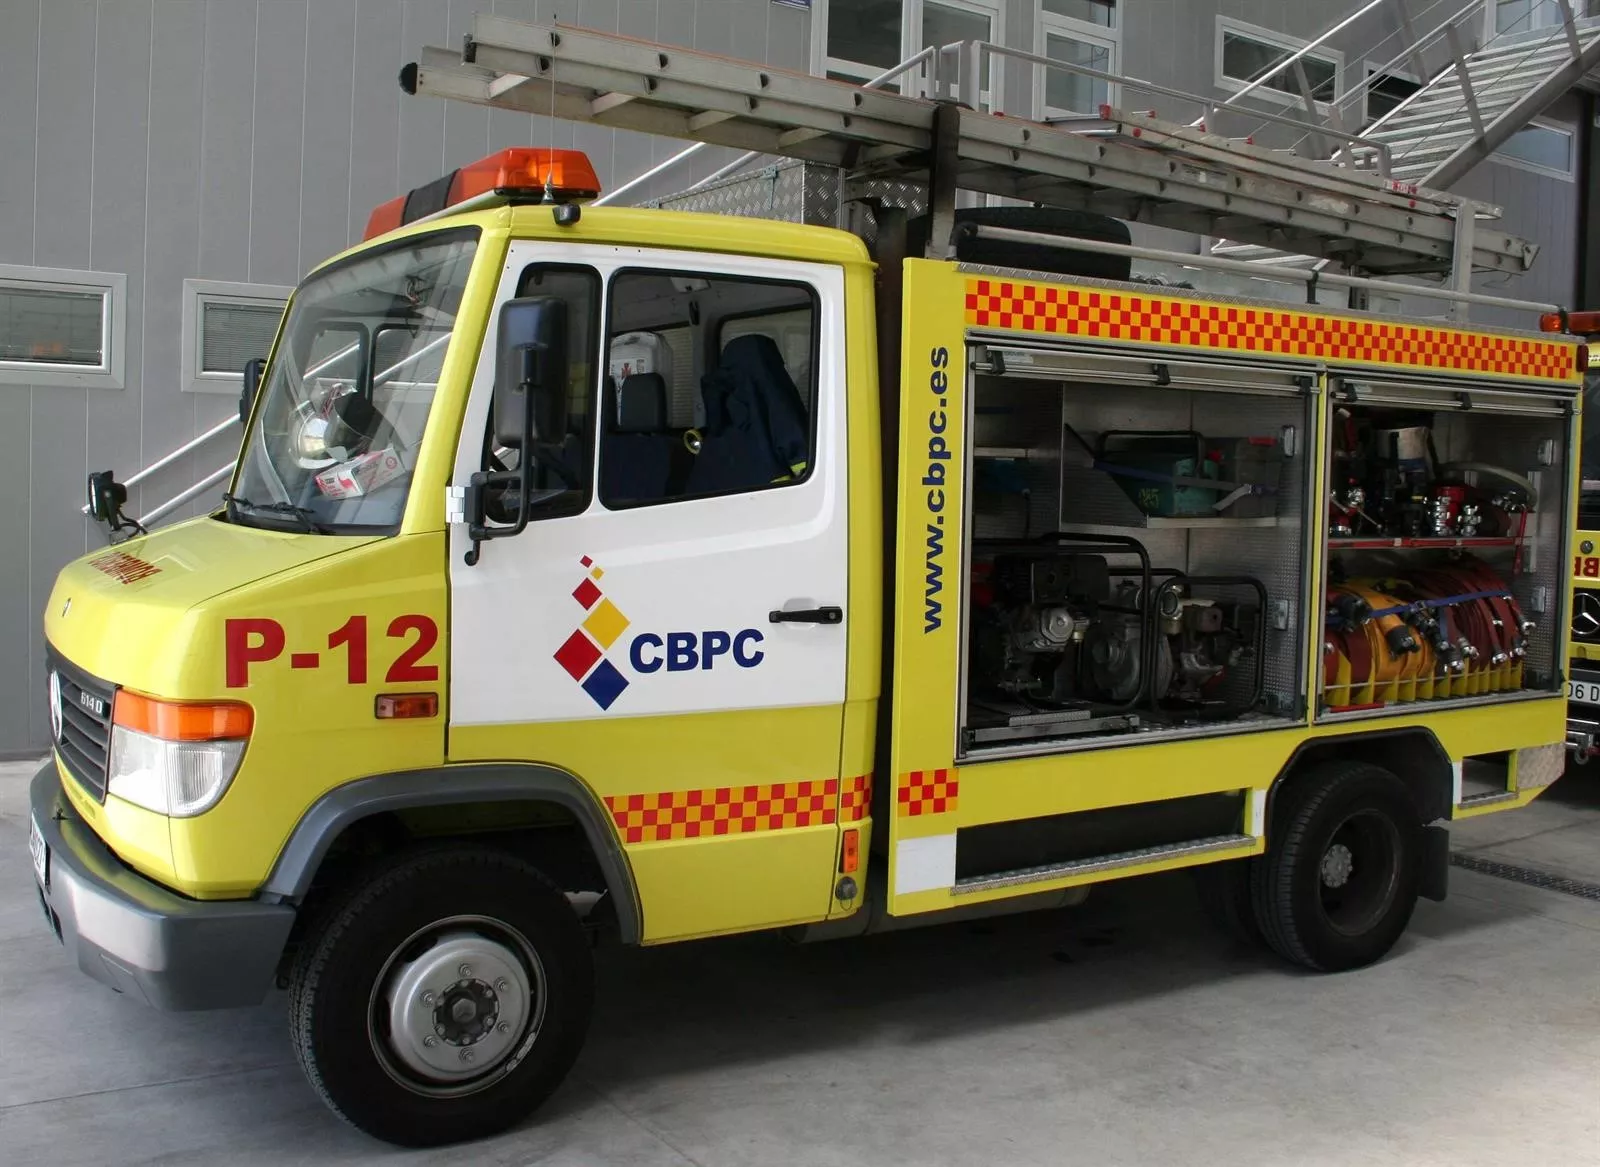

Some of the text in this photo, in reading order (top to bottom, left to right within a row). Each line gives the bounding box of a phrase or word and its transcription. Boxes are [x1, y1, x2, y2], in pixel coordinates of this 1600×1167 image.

[922, 346, 951, 634] www.cbpc.es
[225, 614, 439, 688] P-12
[629, 628, 765, 674] CBPC
[81, 692, 103, 714] 614 D
